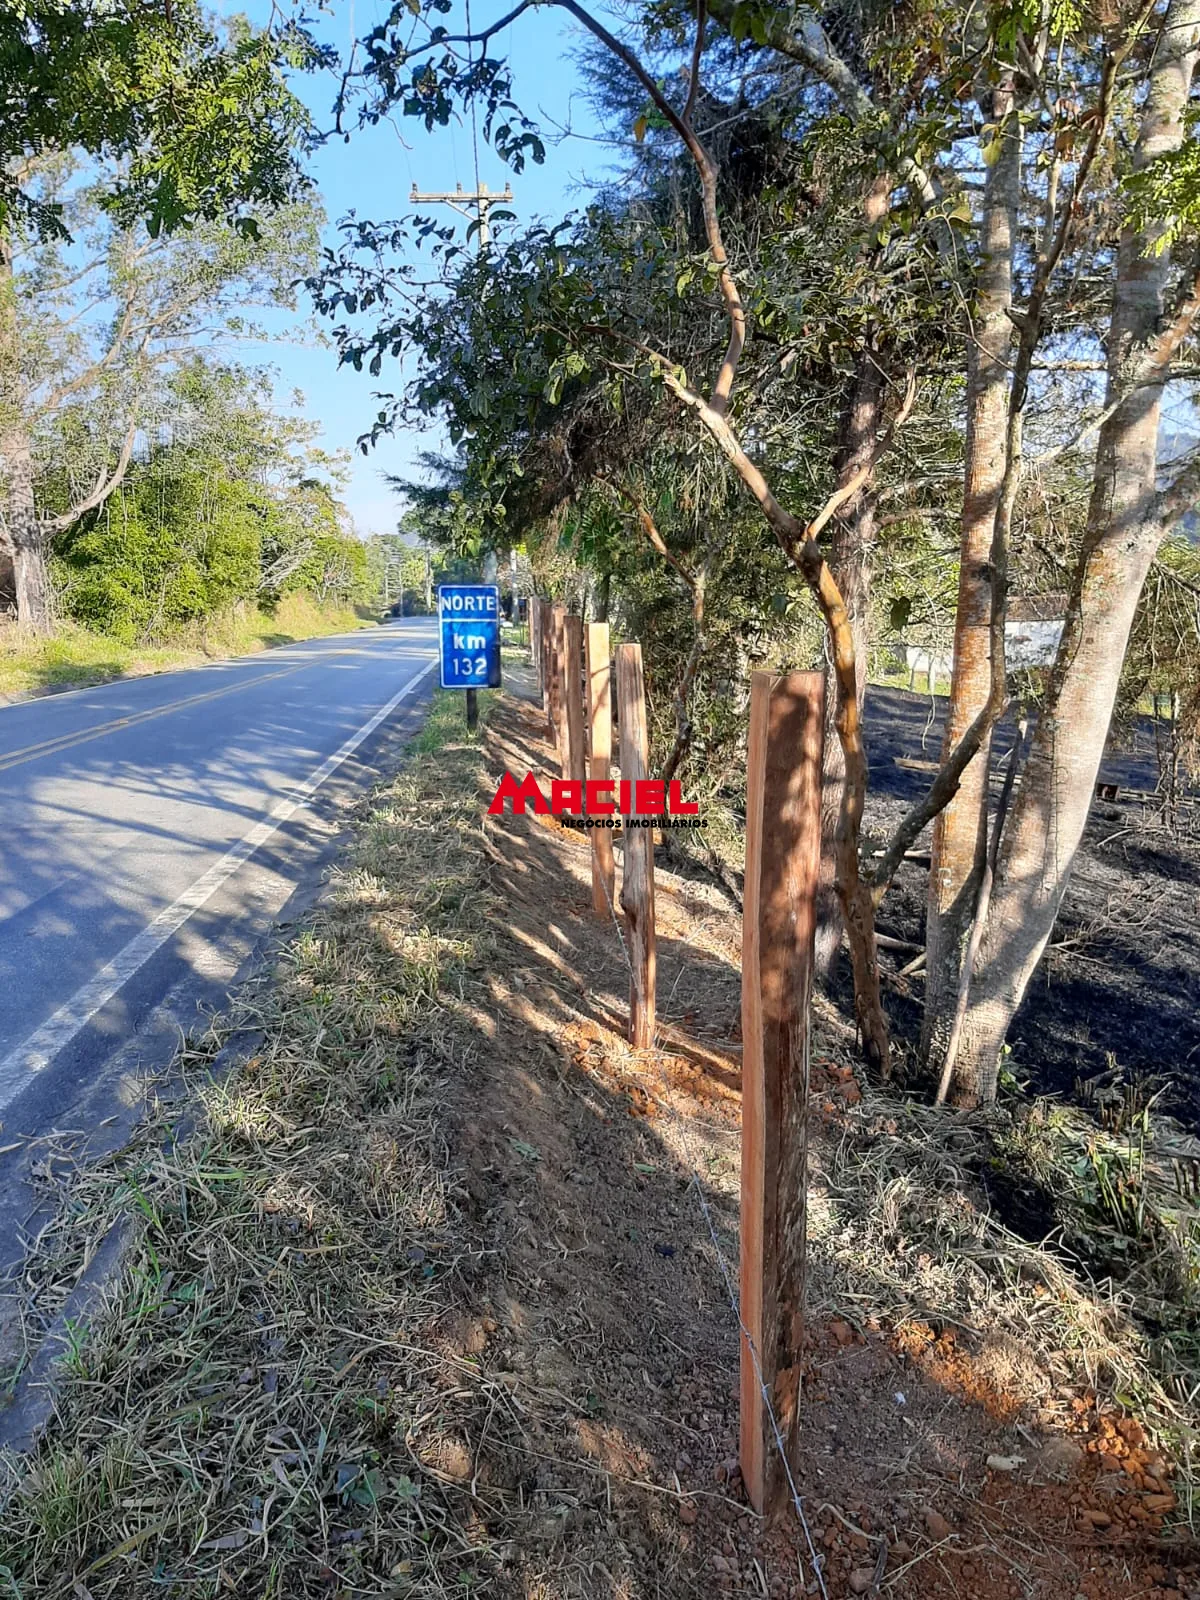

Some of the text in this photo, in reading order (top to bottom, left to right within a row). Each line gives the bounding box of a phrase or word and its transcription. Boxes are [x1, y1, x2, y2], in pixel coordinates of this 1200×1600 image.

[441, 595, 496, 611] NORTE
[453, 633, 486, 649] km
[453, 658, 487, 675] 132
